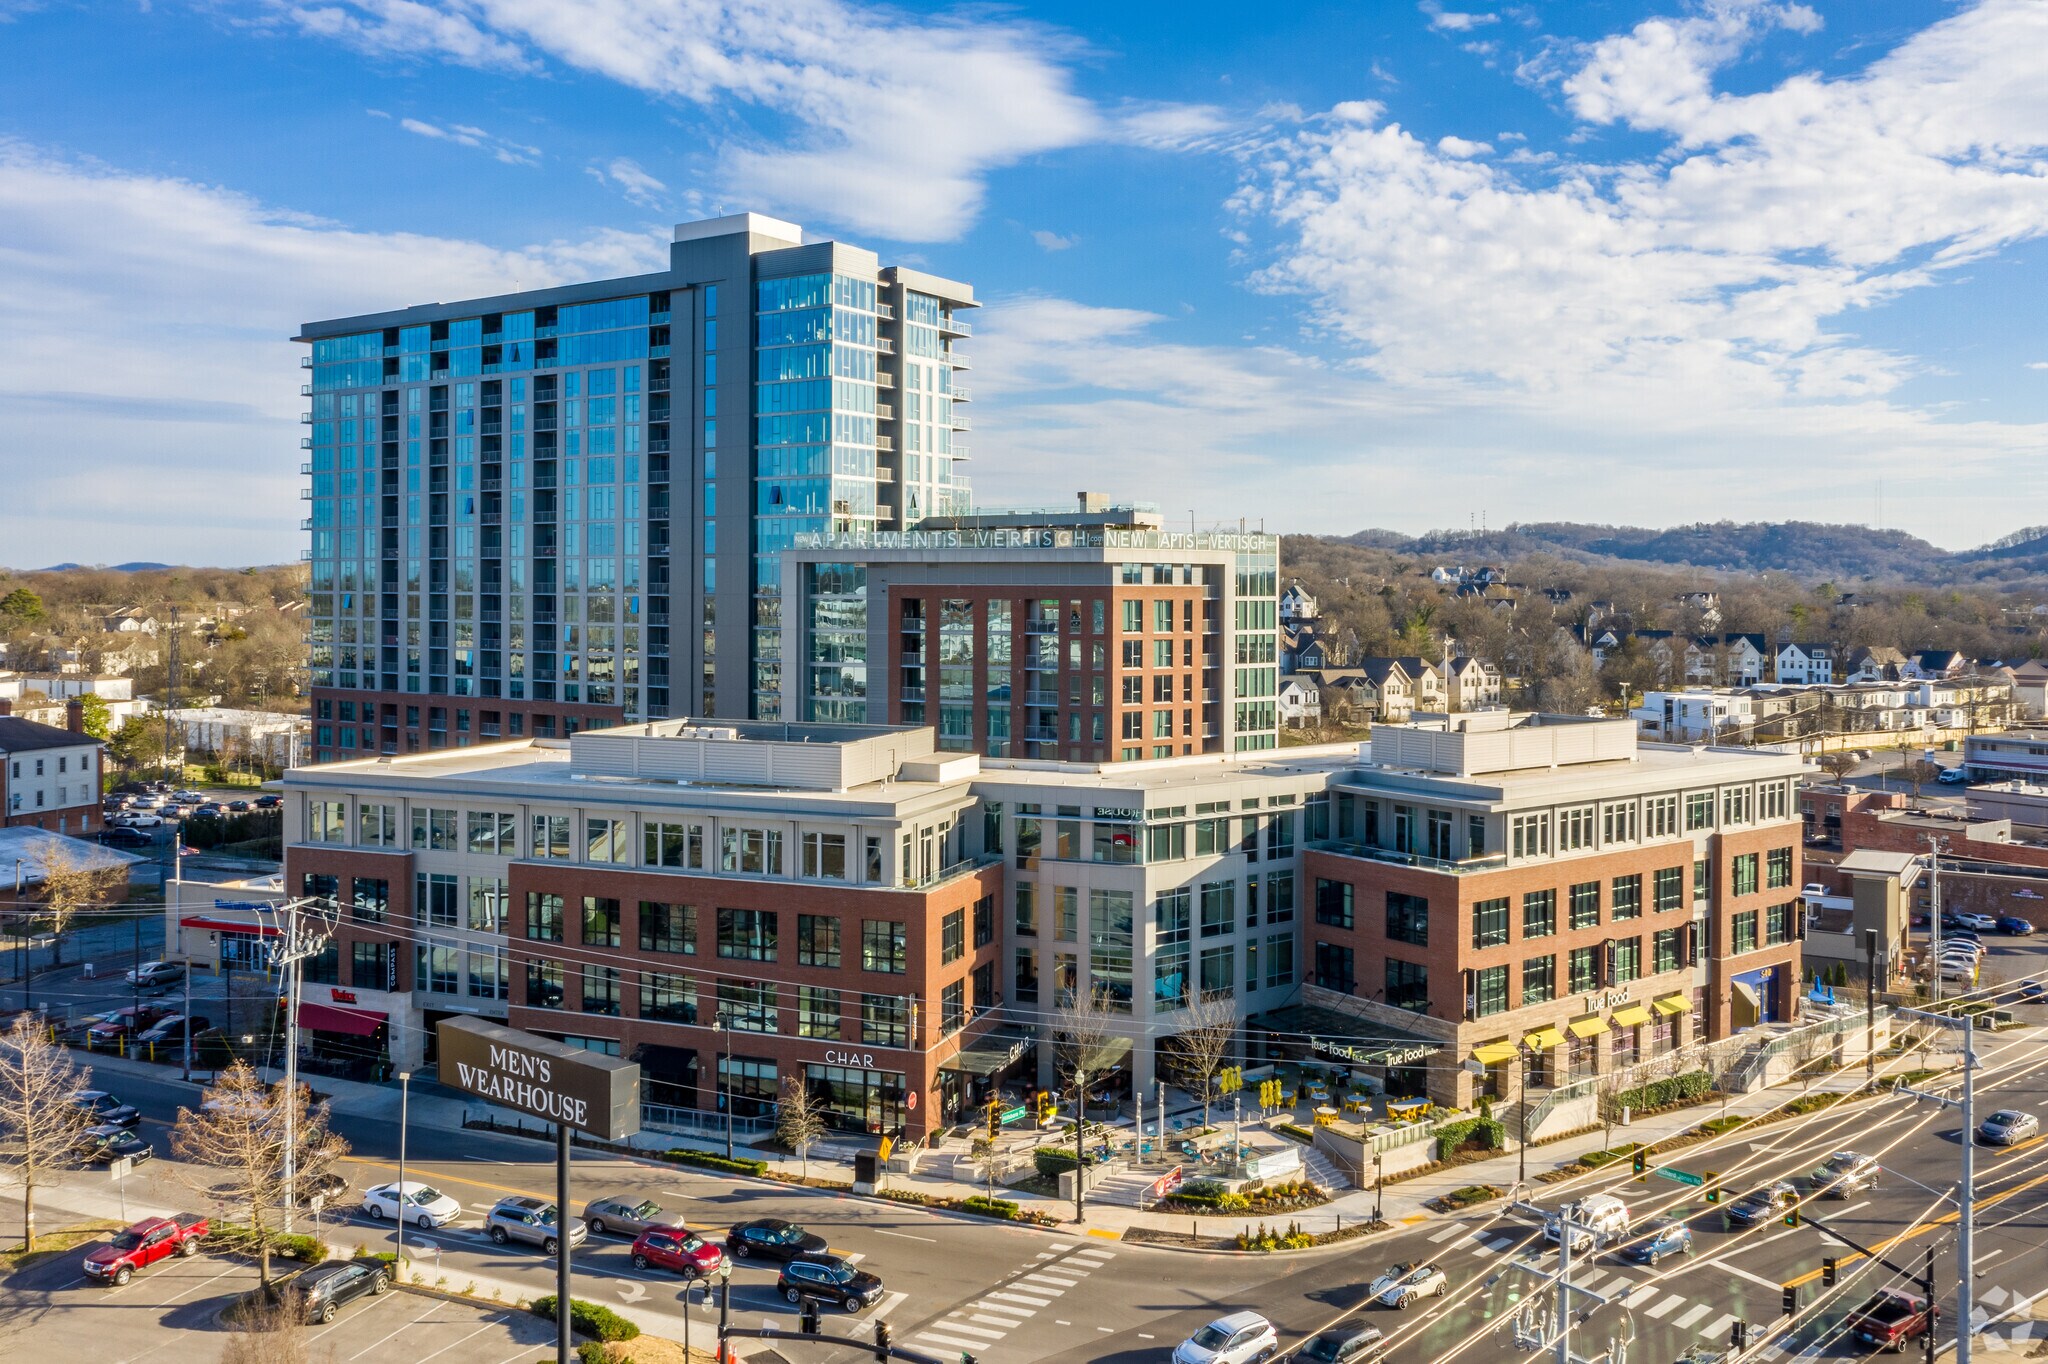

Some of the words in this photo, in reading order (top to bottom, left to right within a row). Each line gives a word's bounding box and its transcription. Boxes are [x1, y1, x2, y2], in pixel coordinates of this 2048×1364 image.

[811, 532, 957, 547] APARTMENTS
[1106, 532, 1145, 547] NEW
[1587, 996, 1605, 1013] True
[1608, 987, 1629, 1007] Food
[825, 1050, 874, 1068] CHAR
[1009, 1036, 1030, 1060] CHAR
[1310, 1036, 1328, 1052] True
[1329, 1042, 1352, 1059] Food
[1386, 1053, 1402, 1067] True
[1404, 1044, 1424, 1061] Food
[489, 1044, 551, 1083] MEN'S
[456, 1062, 588, 1126] WEARHOUSE
